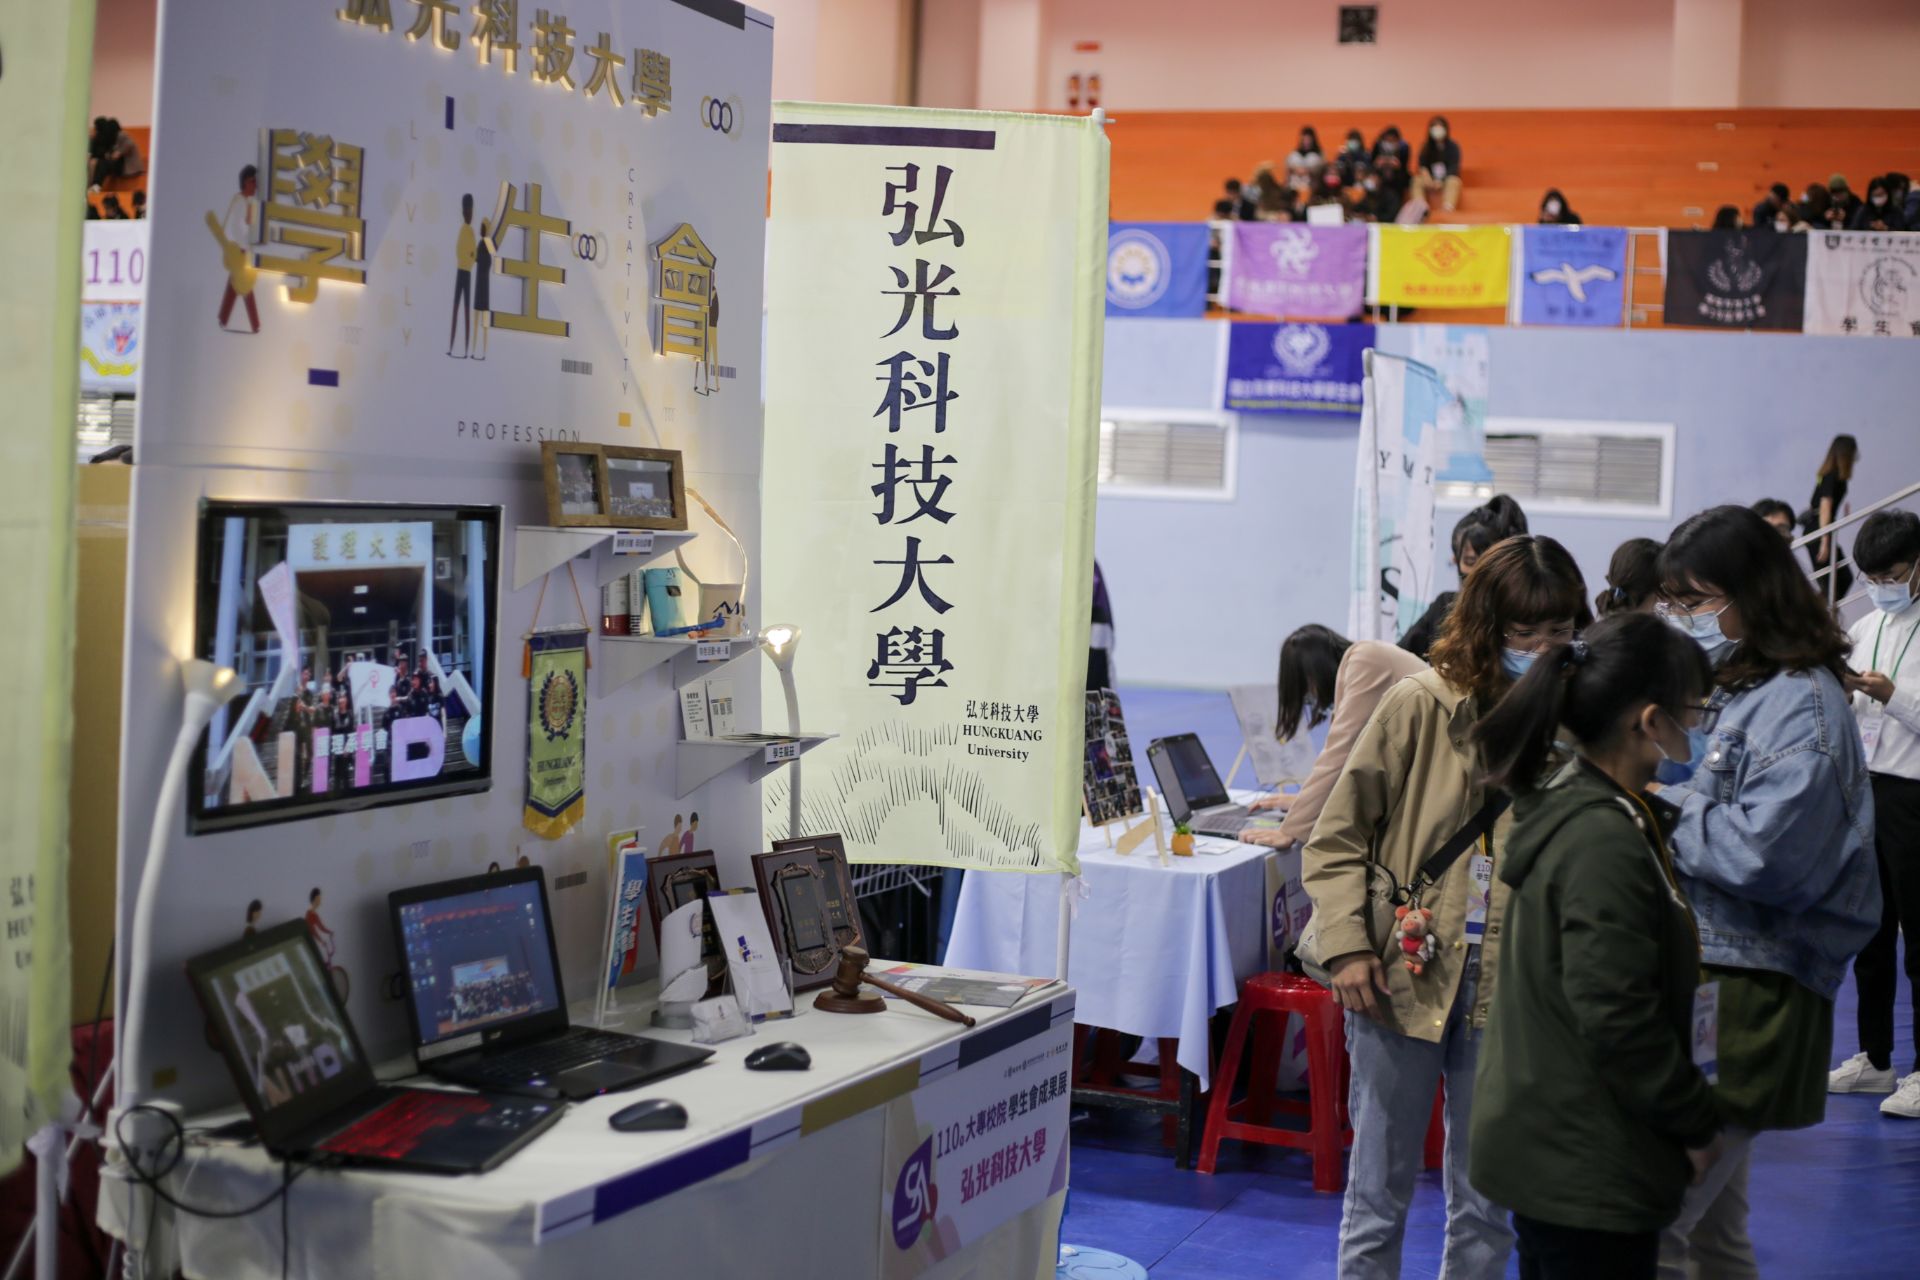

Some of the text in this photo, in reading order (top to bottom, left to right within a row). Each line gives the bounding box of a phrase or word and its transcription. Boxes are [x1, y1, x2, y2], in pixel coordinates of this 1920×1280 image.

[621, 167, 635, 396] CREATIVITY
[456, 420, 581, 444] PROFESSION
[866, 162, 965, 706] 弘光科技大學
[966, 699, 1040, 724] 弘光科技大學
[962, 723, 1043, 742] HUNGKUANG
[967, 743, 1030, 763] University
[960, 1127, 1047, 1205] 弘光科技大學
